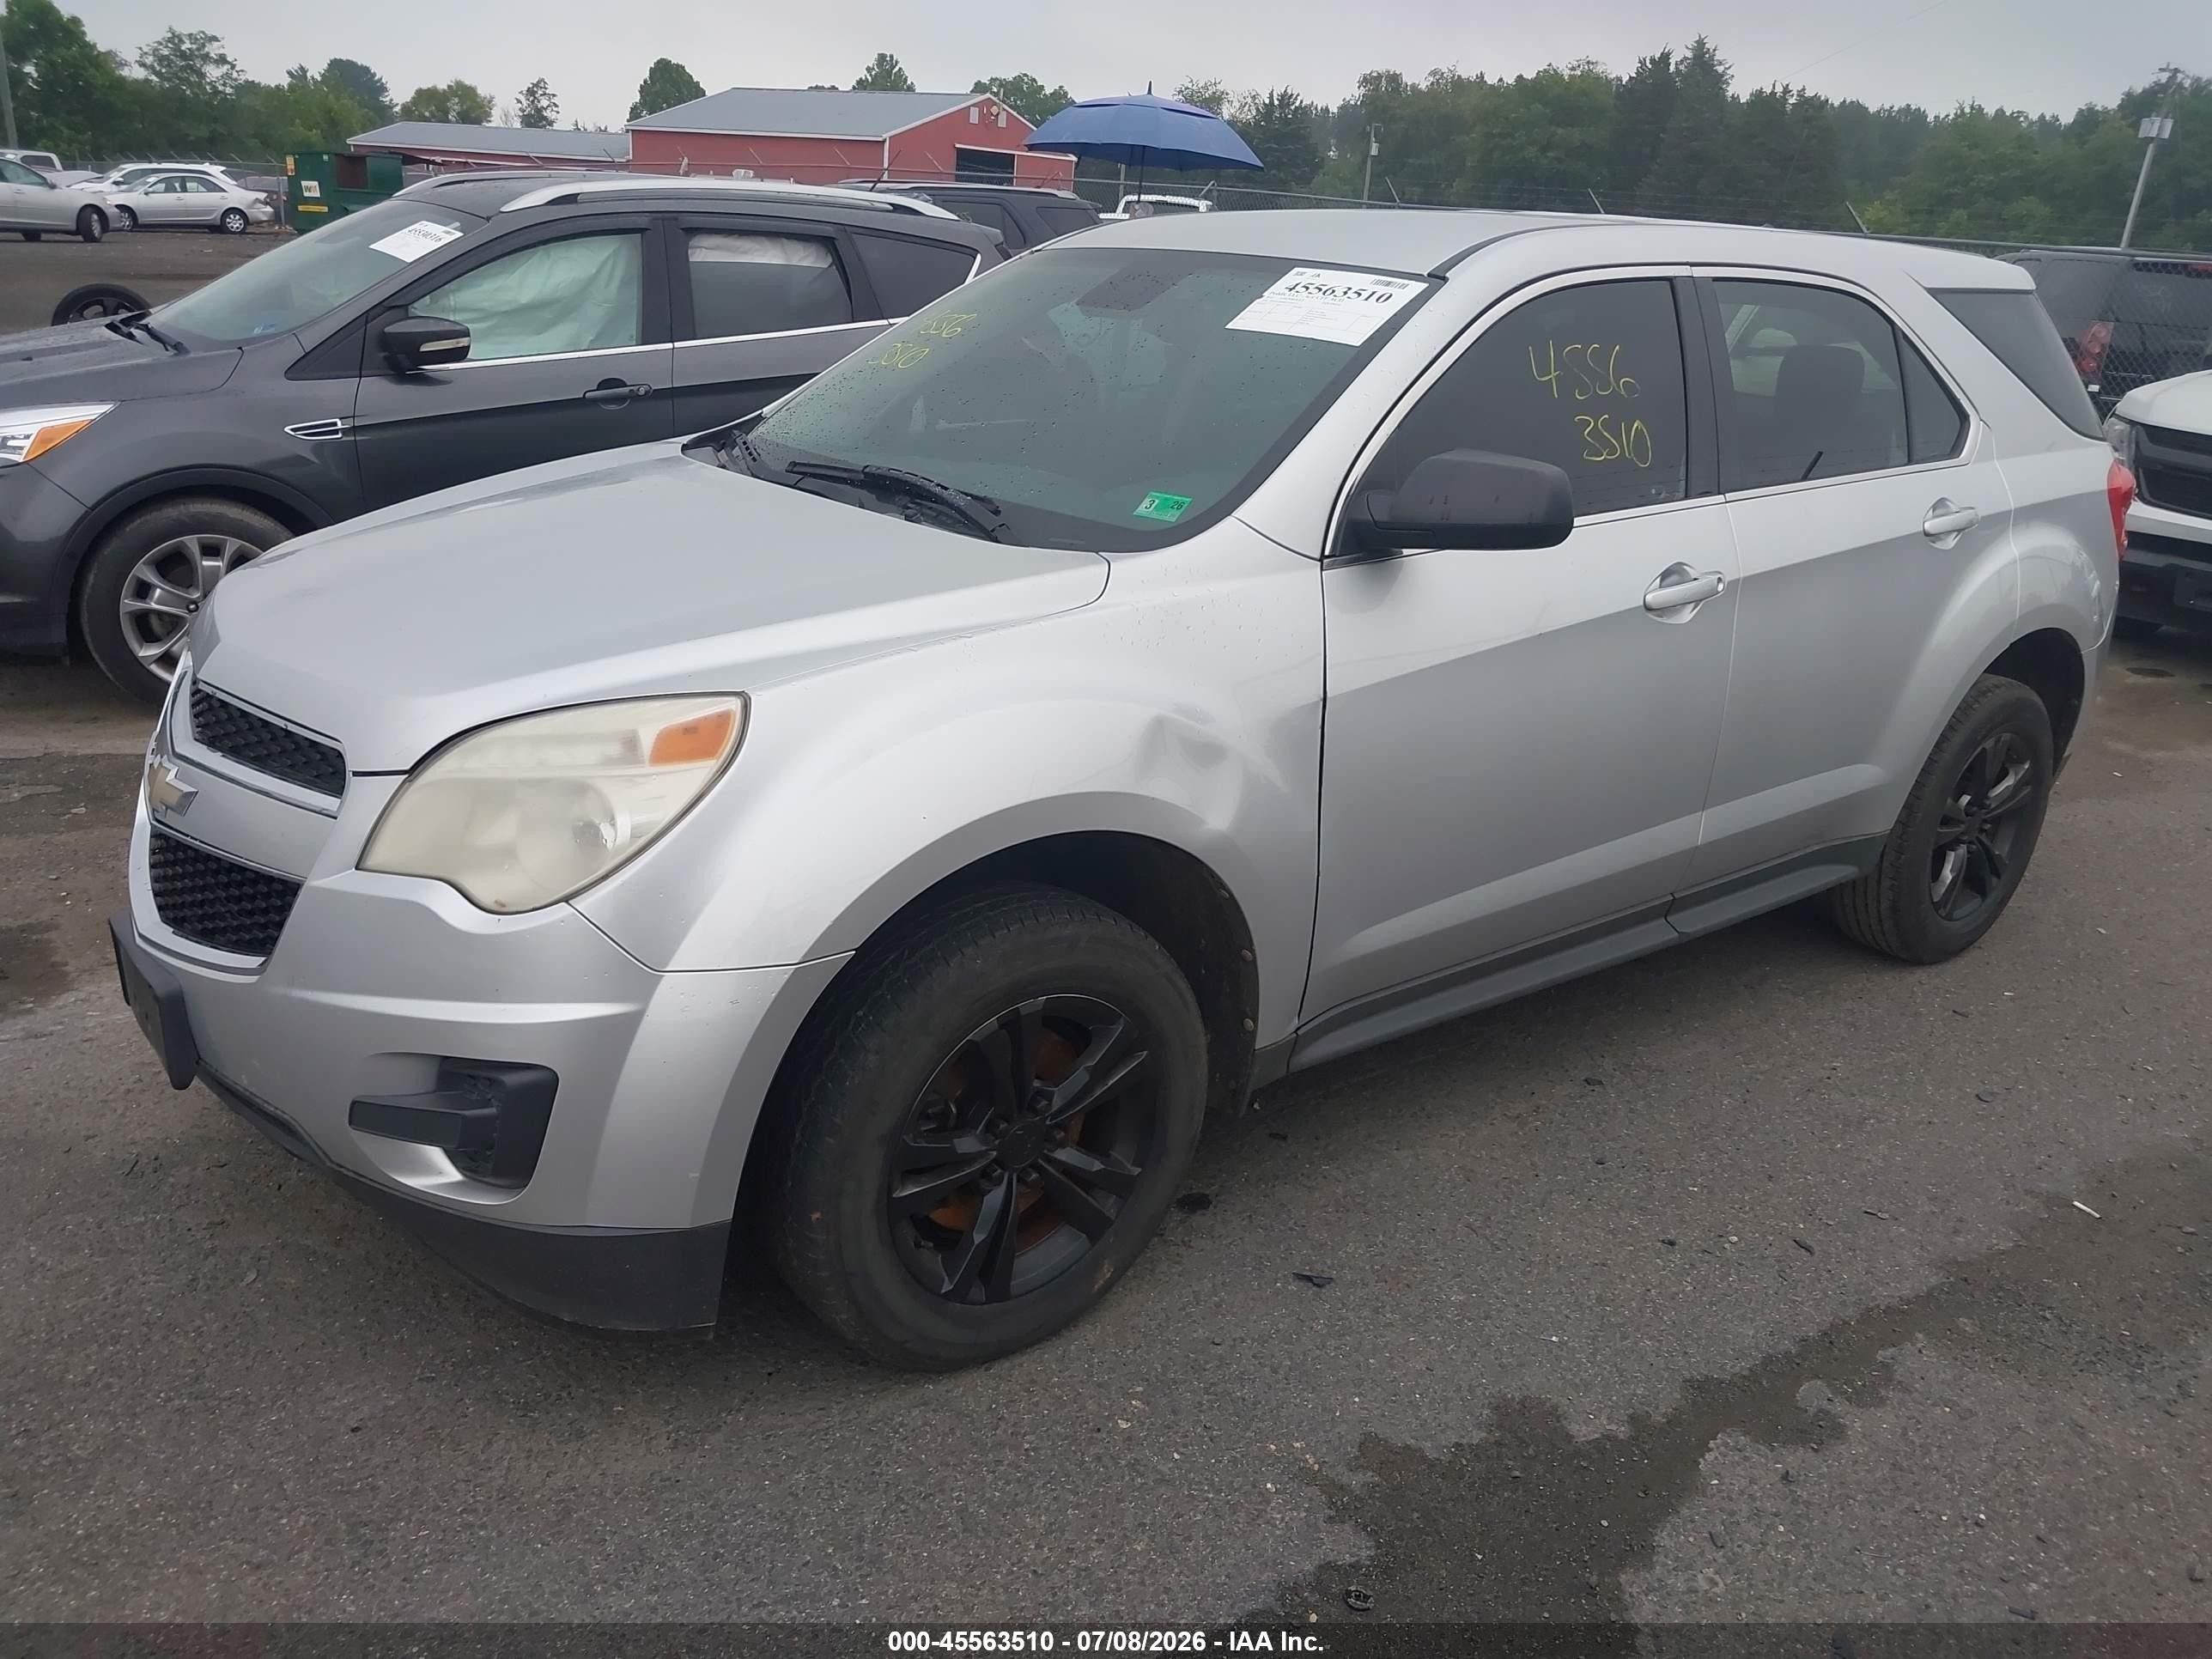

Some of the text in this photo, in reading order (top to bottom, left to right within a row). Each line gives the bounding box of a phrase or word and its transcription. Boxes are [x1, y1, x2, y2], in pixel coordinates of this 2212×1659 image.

[1285, 281, 1394, 304] 45563510
[1528, 339, 1641, 399] 4556
[1574, 415, 1651, 467] 3510
[1145, 499, 1186, 510] 3 26
